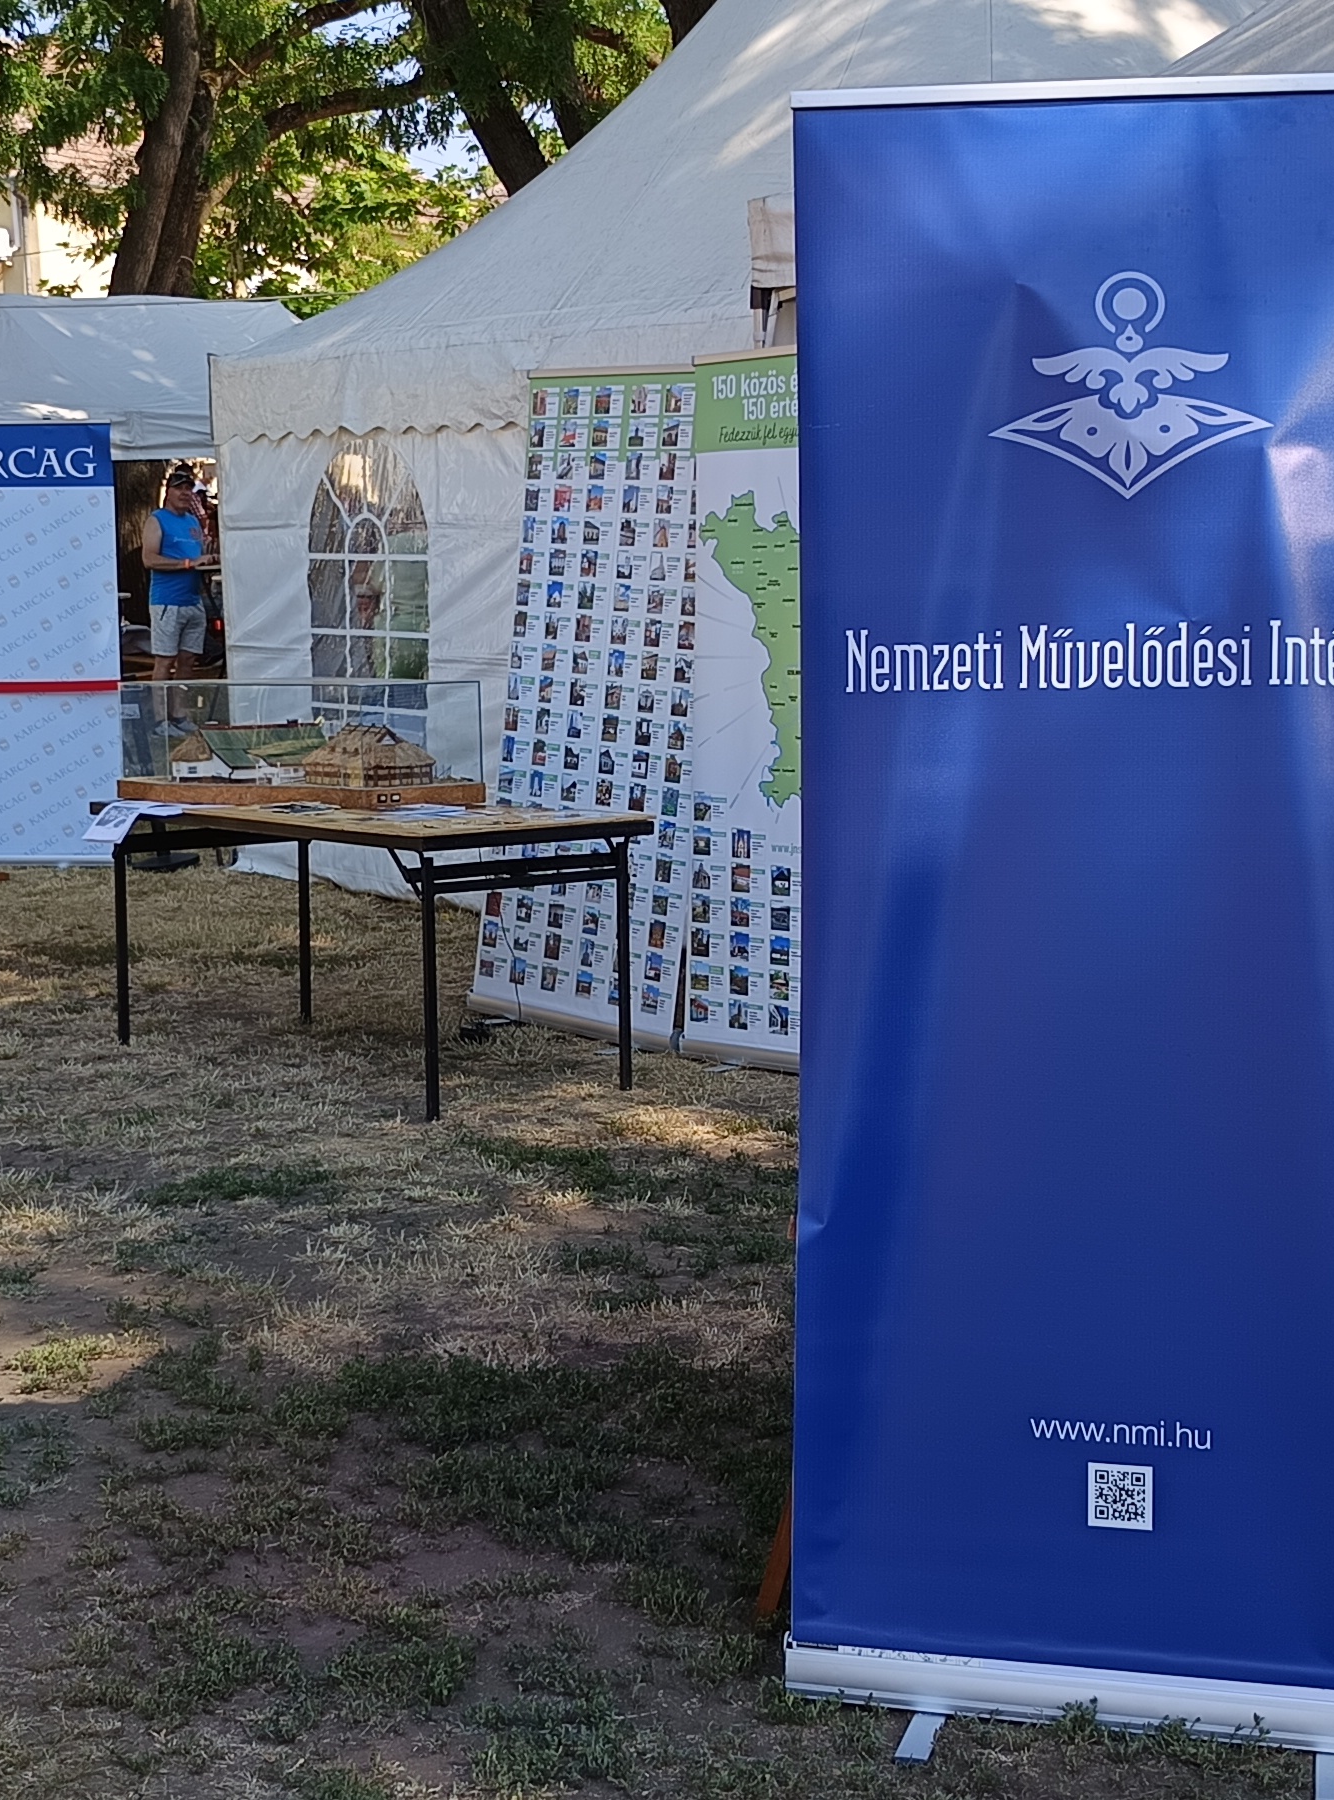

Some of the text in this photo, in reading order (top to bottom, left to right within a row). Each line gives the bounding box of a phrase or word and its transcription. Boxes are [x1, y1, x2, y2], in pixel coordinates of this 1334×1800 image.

[712, 374, 736, 400] 150
[740, 369, 786, 397] közös
[742, 397, 766, 420] 150
[718, 423, 762, 444] Fedezzük
[762, 422, 777, 446] fel
[41, 505, 85, 536] KARCAG
[23, 547, 67, 579] KARCAG
[11, 587, 55, 618] KARCAG
[56, 591, 99, 622] KARCAG
[43, 631, 87, 661] KARCAG
[845, 628, 1004, 693] Nemzeti
[1019, 621, 1252, 690] Művelődési
[13, 711, 57, 742] KARCAG
[59, 716, 102, 747] KARCAG
[46, 754, 89, 785] KARCAG
[28, 796, 72, 826] KARCAG
[24, 834, 59, 856] ARCAG
[1030, 1418, 1211, 1450] www.nmi.hu
